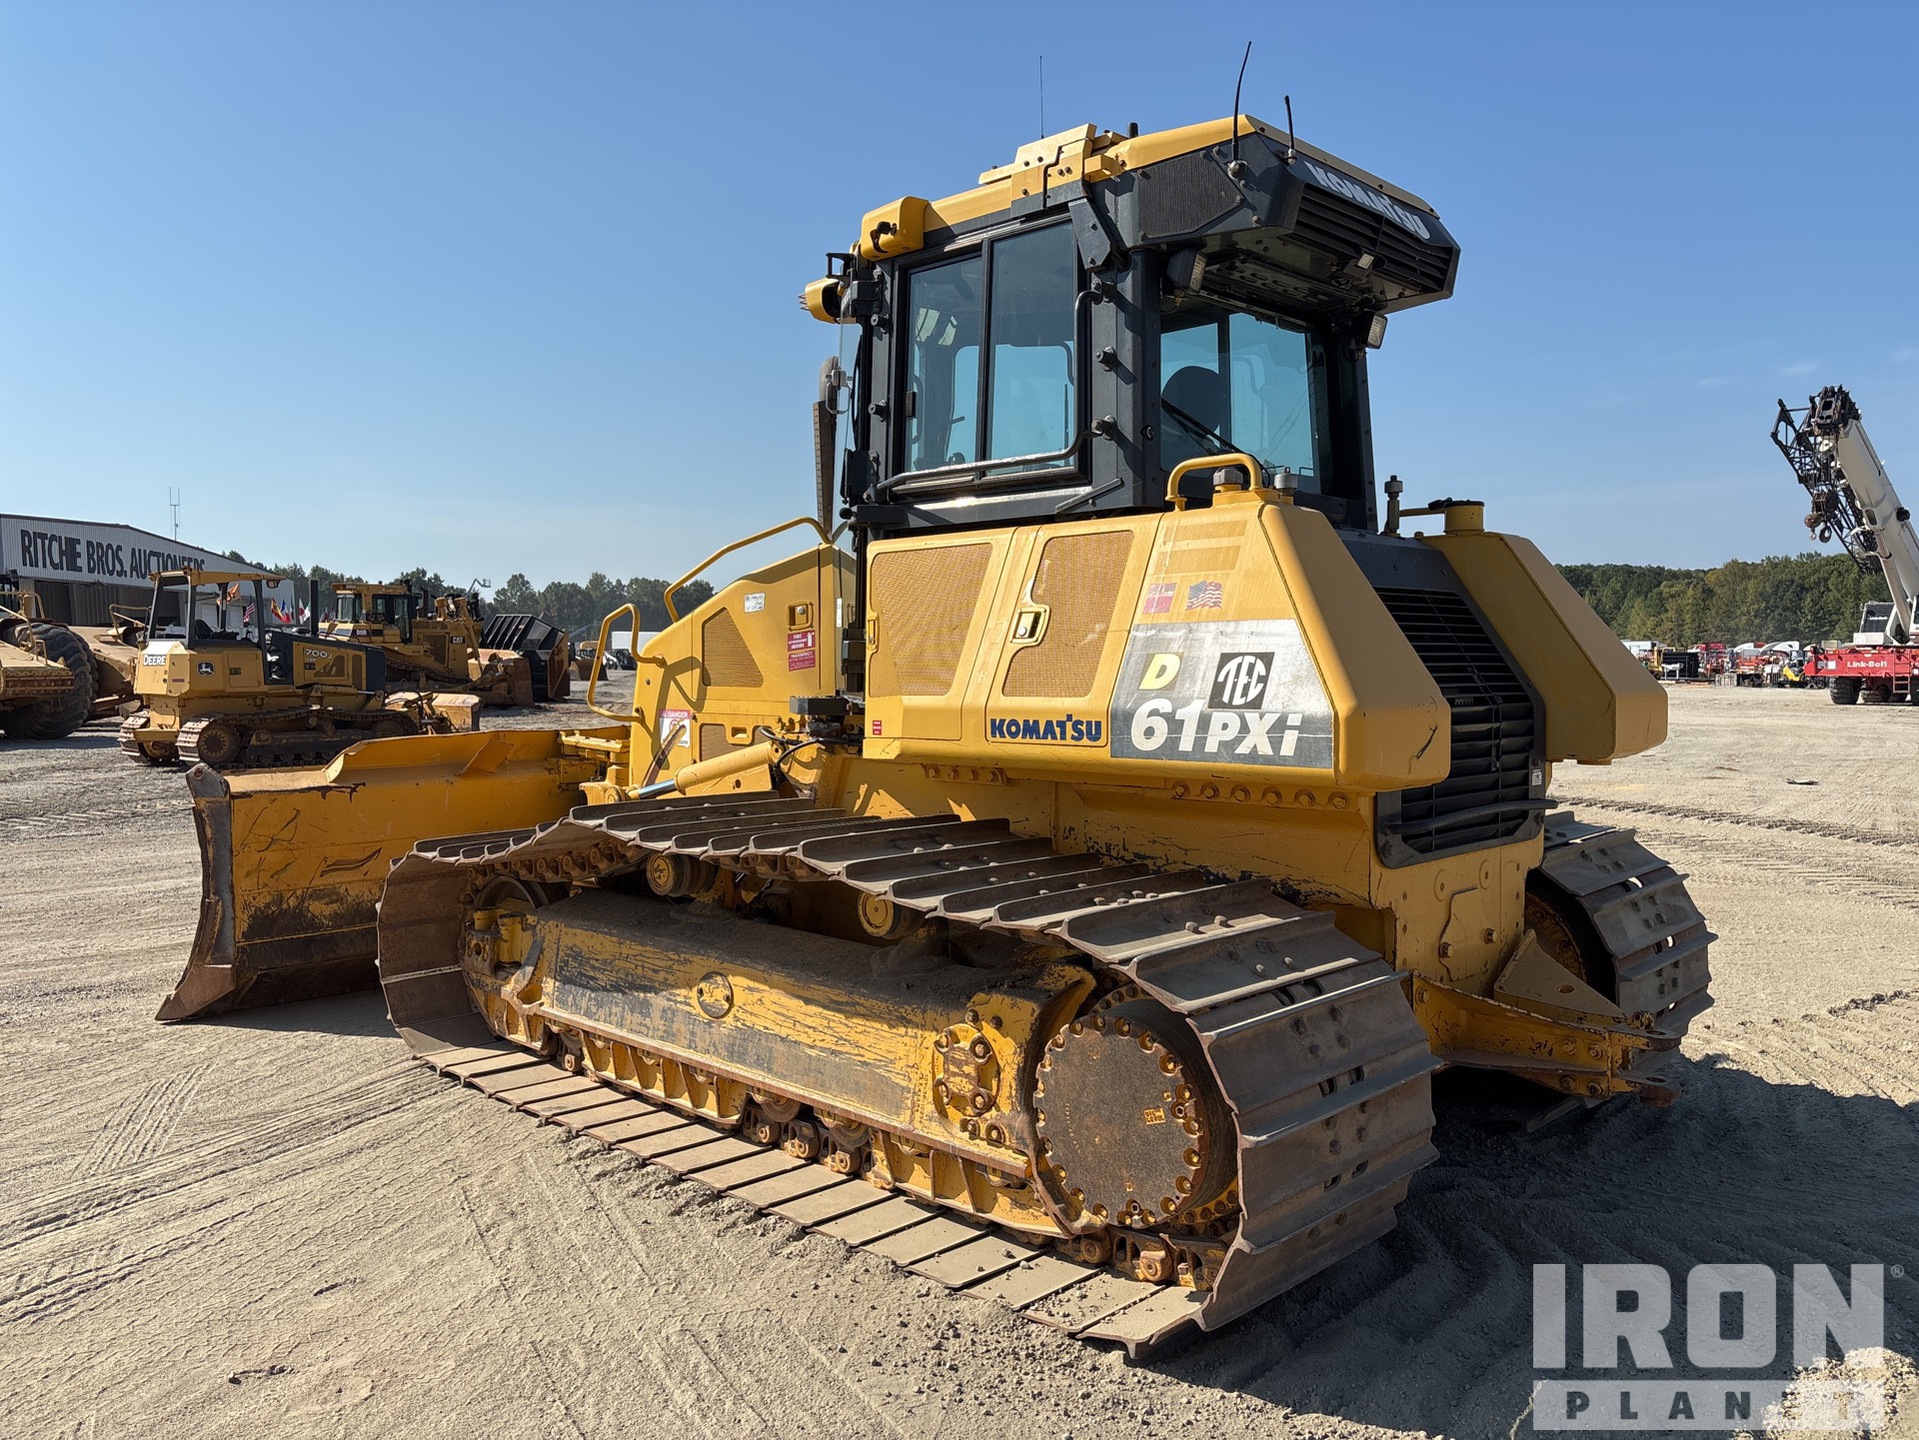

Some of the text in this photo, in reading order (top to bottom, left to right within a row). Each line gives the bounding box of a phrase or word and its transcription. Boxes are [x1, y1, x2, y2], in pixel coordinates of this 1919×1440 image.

[1304, 161, 1431, 240] KOMATSU
[86, 540, 127, 577] BROS.
[143, 655, 166, 666] DEERE
[1138, 653, 1181, 690] D
[1847, 660, 1888, 668] Link-Belt
[990, 713, 1102, 742] KOMATSU
